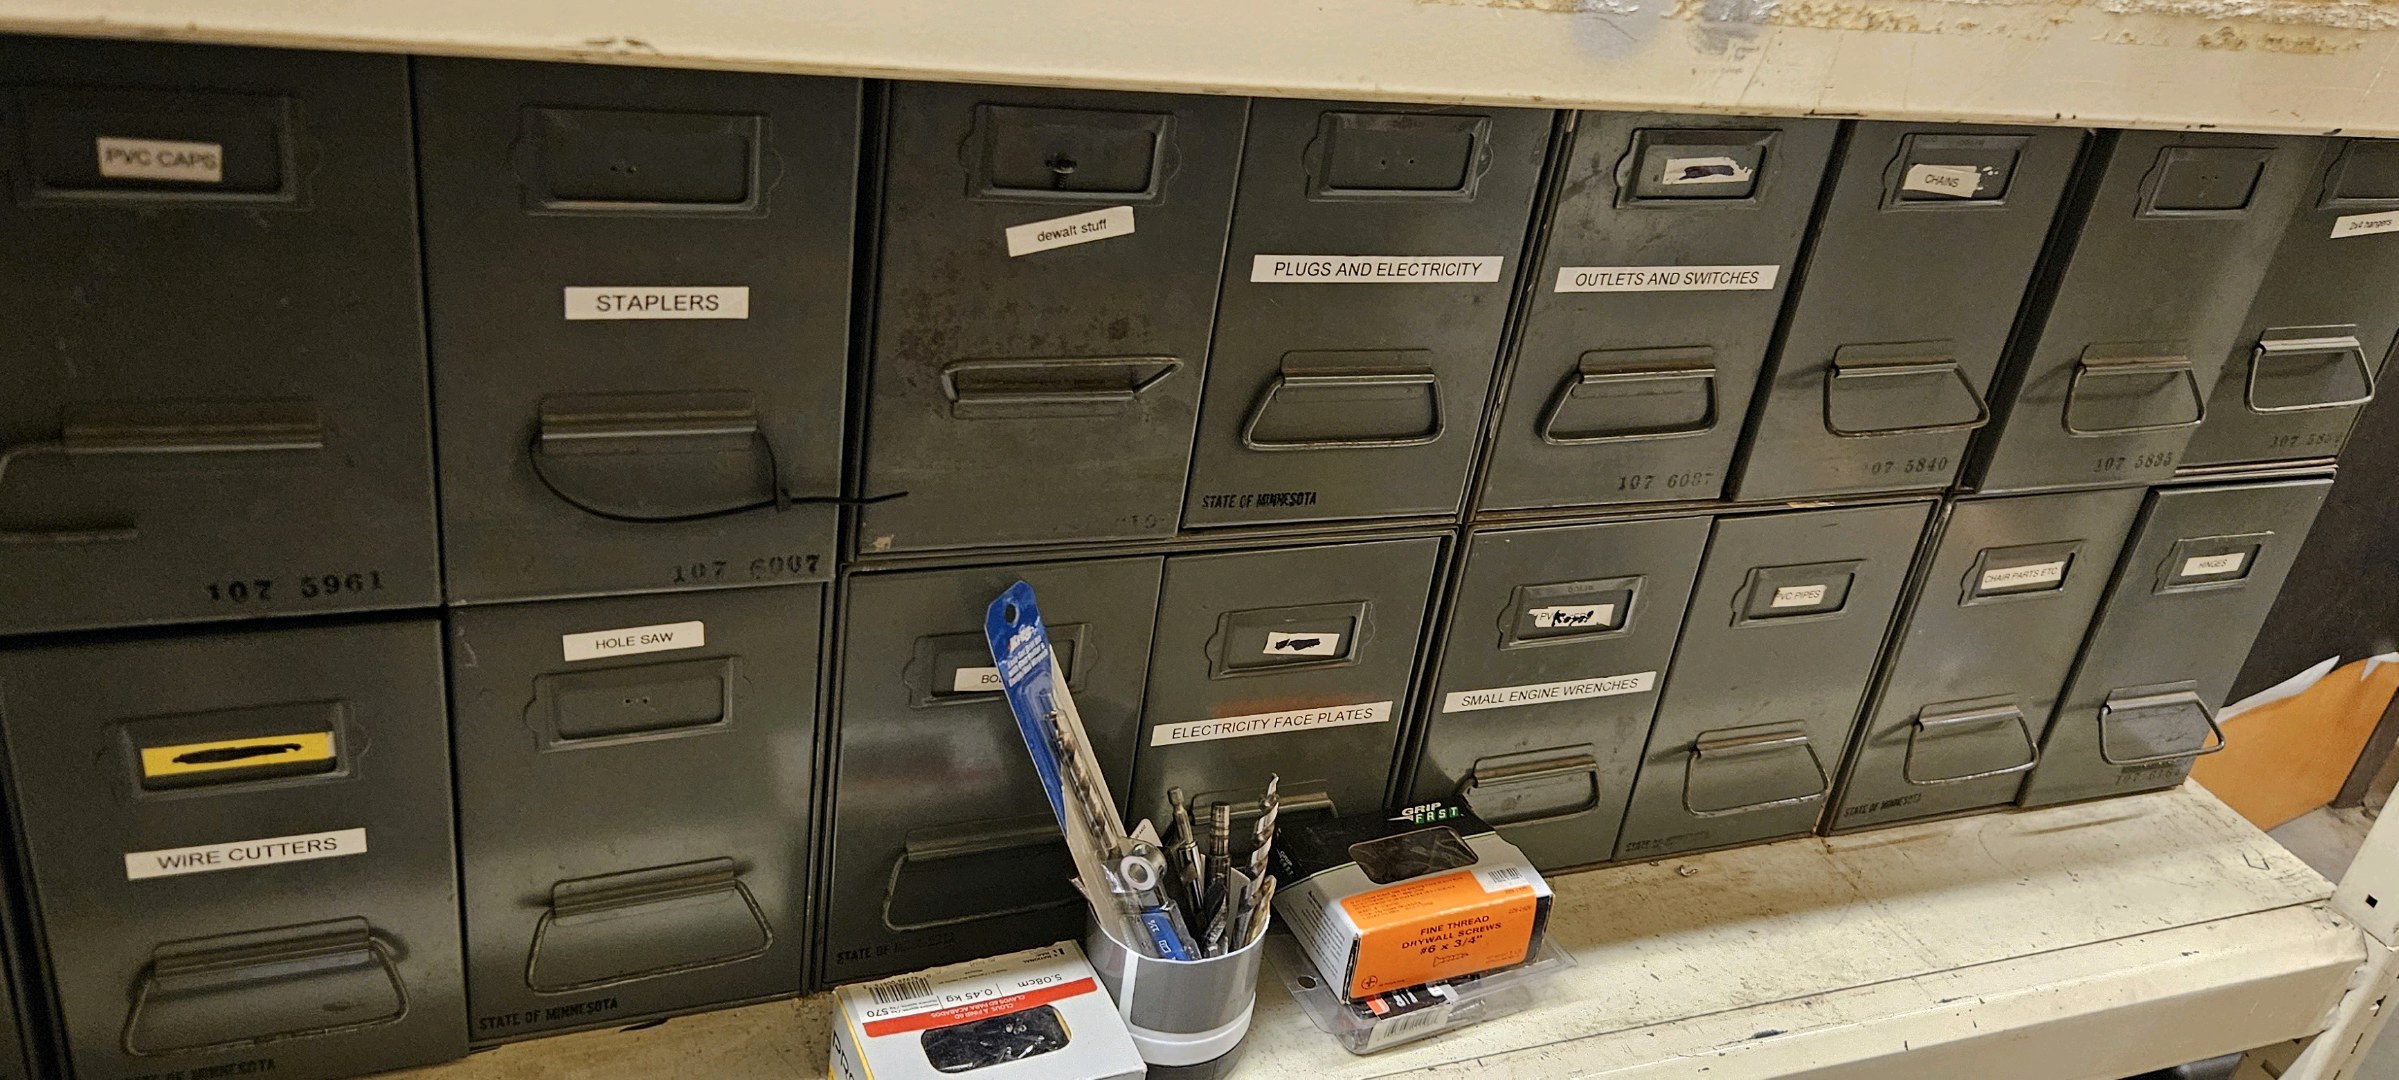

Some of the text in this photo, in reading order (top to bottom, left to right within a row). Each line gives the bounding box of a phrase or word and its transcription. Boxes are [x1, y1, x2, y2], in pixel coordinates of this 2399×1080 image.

[105, 147, 218, 171] PVC CAPS
[1037, 218, 1107, 242] dewalt stuff
[1274, 261, 1482, 277] PLUGS AND ELECTRICITY
[1575, 270, 1760, 287] OUTLETS AND SWITCHES
[596, 294, 720, 312] STAPLERS
[1904, 456, 1948, 474] 5840
[1202, 494, 1237, 509] STATE
[1240, 494, 1254, 509] OF
[673, 560, 727, 584] 107
[1985, 573, 2010, 584] CHAIR
[2012, 569, 2039, 579] PARTS
[205, 570, 385, 602] 107 5961
[595, 632, 674, 650] HOLE SAW
[981, 674, 1002, 684] BO
[1461, 678, 1639, 708] SMALL ENGINE WRENCHES
[1172, 707, 1373, 740] ELECTRICITY FACE PLATES
[1402, 802, 1441, 816] GRIP
[157, 837, 338, 870] WIRE CUTTERS
[1420, 915, 1490, 935] FINE THREAD
[1402, 922, 1502, 949] DRYWALL SCREWS
[1420, 944, 1436, 955] #6
[1017, 973, 1063, 987] 5.08cm
[945, 988, 993, 1003] 0.45 kg
[480, 997, 619, 1030] STATE OF MINNESOTA
[866, 1008, 889, 1018] 570
